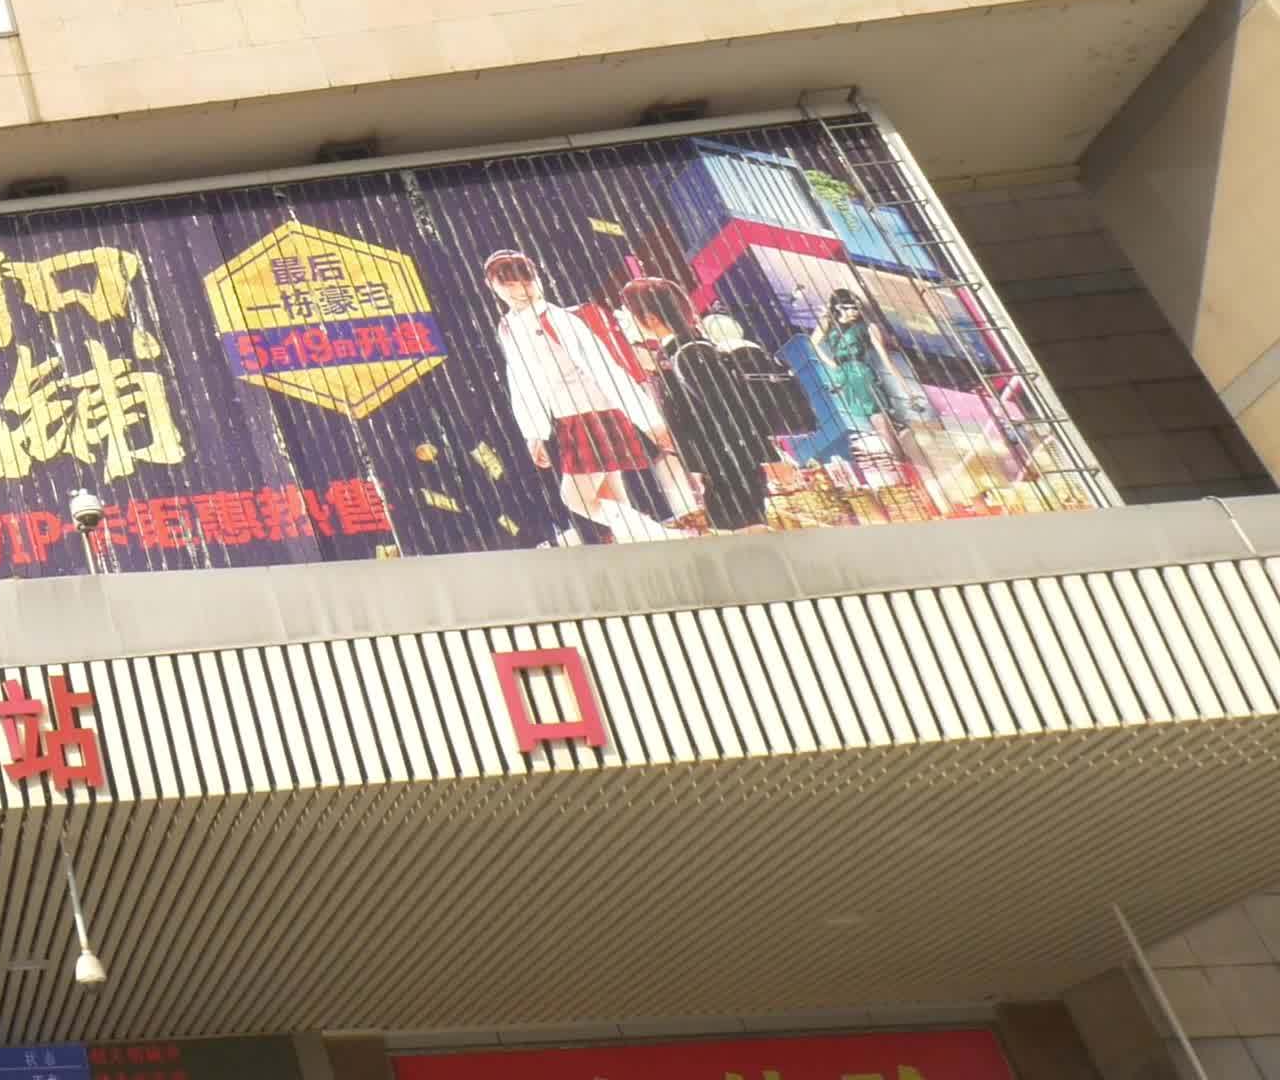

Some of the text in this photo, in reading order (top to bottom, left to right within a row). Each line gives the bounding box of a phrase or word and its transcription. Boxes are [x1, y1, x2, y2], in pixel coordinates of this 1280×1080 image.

[272, 253, 345, 286] 最后
[246, 282, 393, 319] 一栋豪宅
[234, 321, 438, 371] 5月19日开盘
